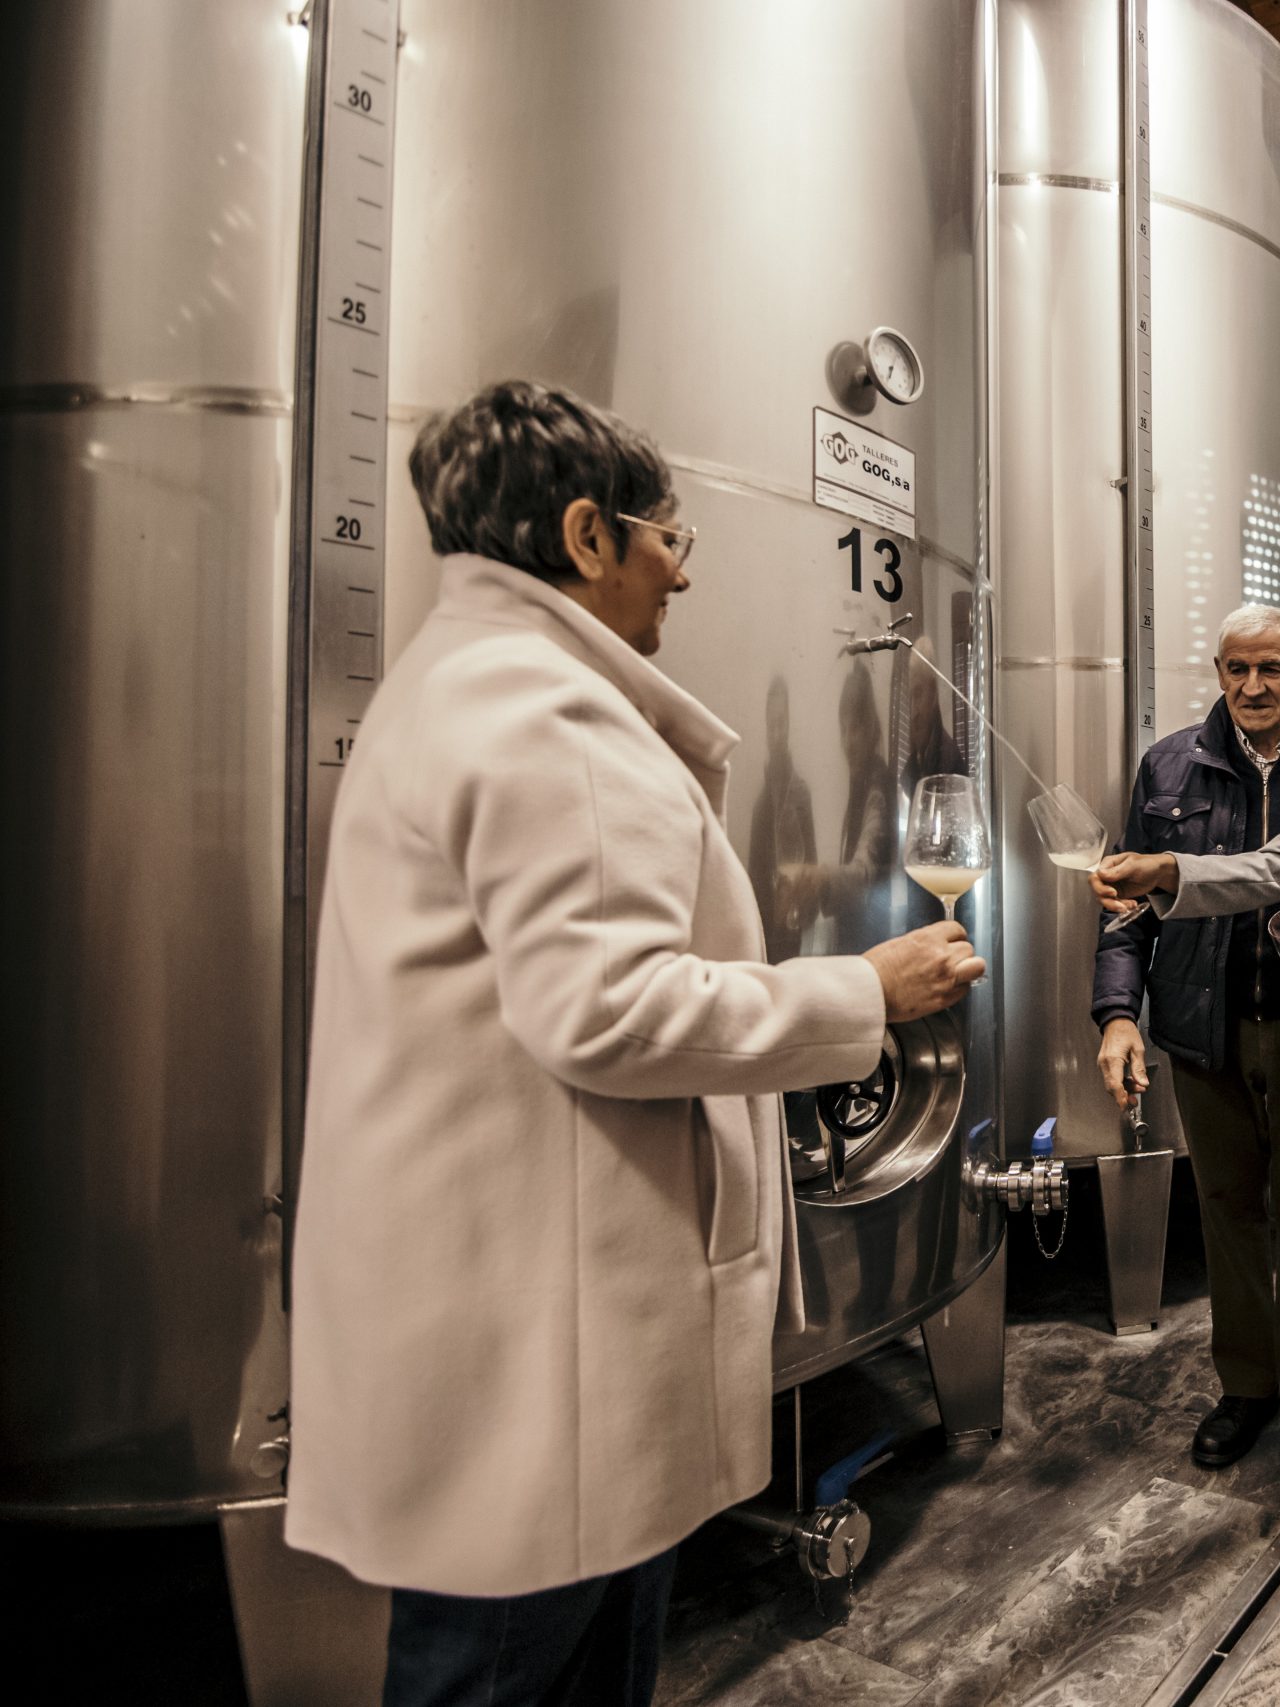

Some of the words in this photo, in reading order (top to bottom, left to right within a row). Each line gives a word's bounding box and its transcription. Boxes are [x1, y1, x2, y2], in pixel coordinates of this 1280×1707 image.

[348, 84, 372, 112] 30
[342, 297, 366, 324] 25
[862, 444, 899, 468] TALLERES
[336, 515, 361, 541] 20
[837, 526, 904, 603] 13
